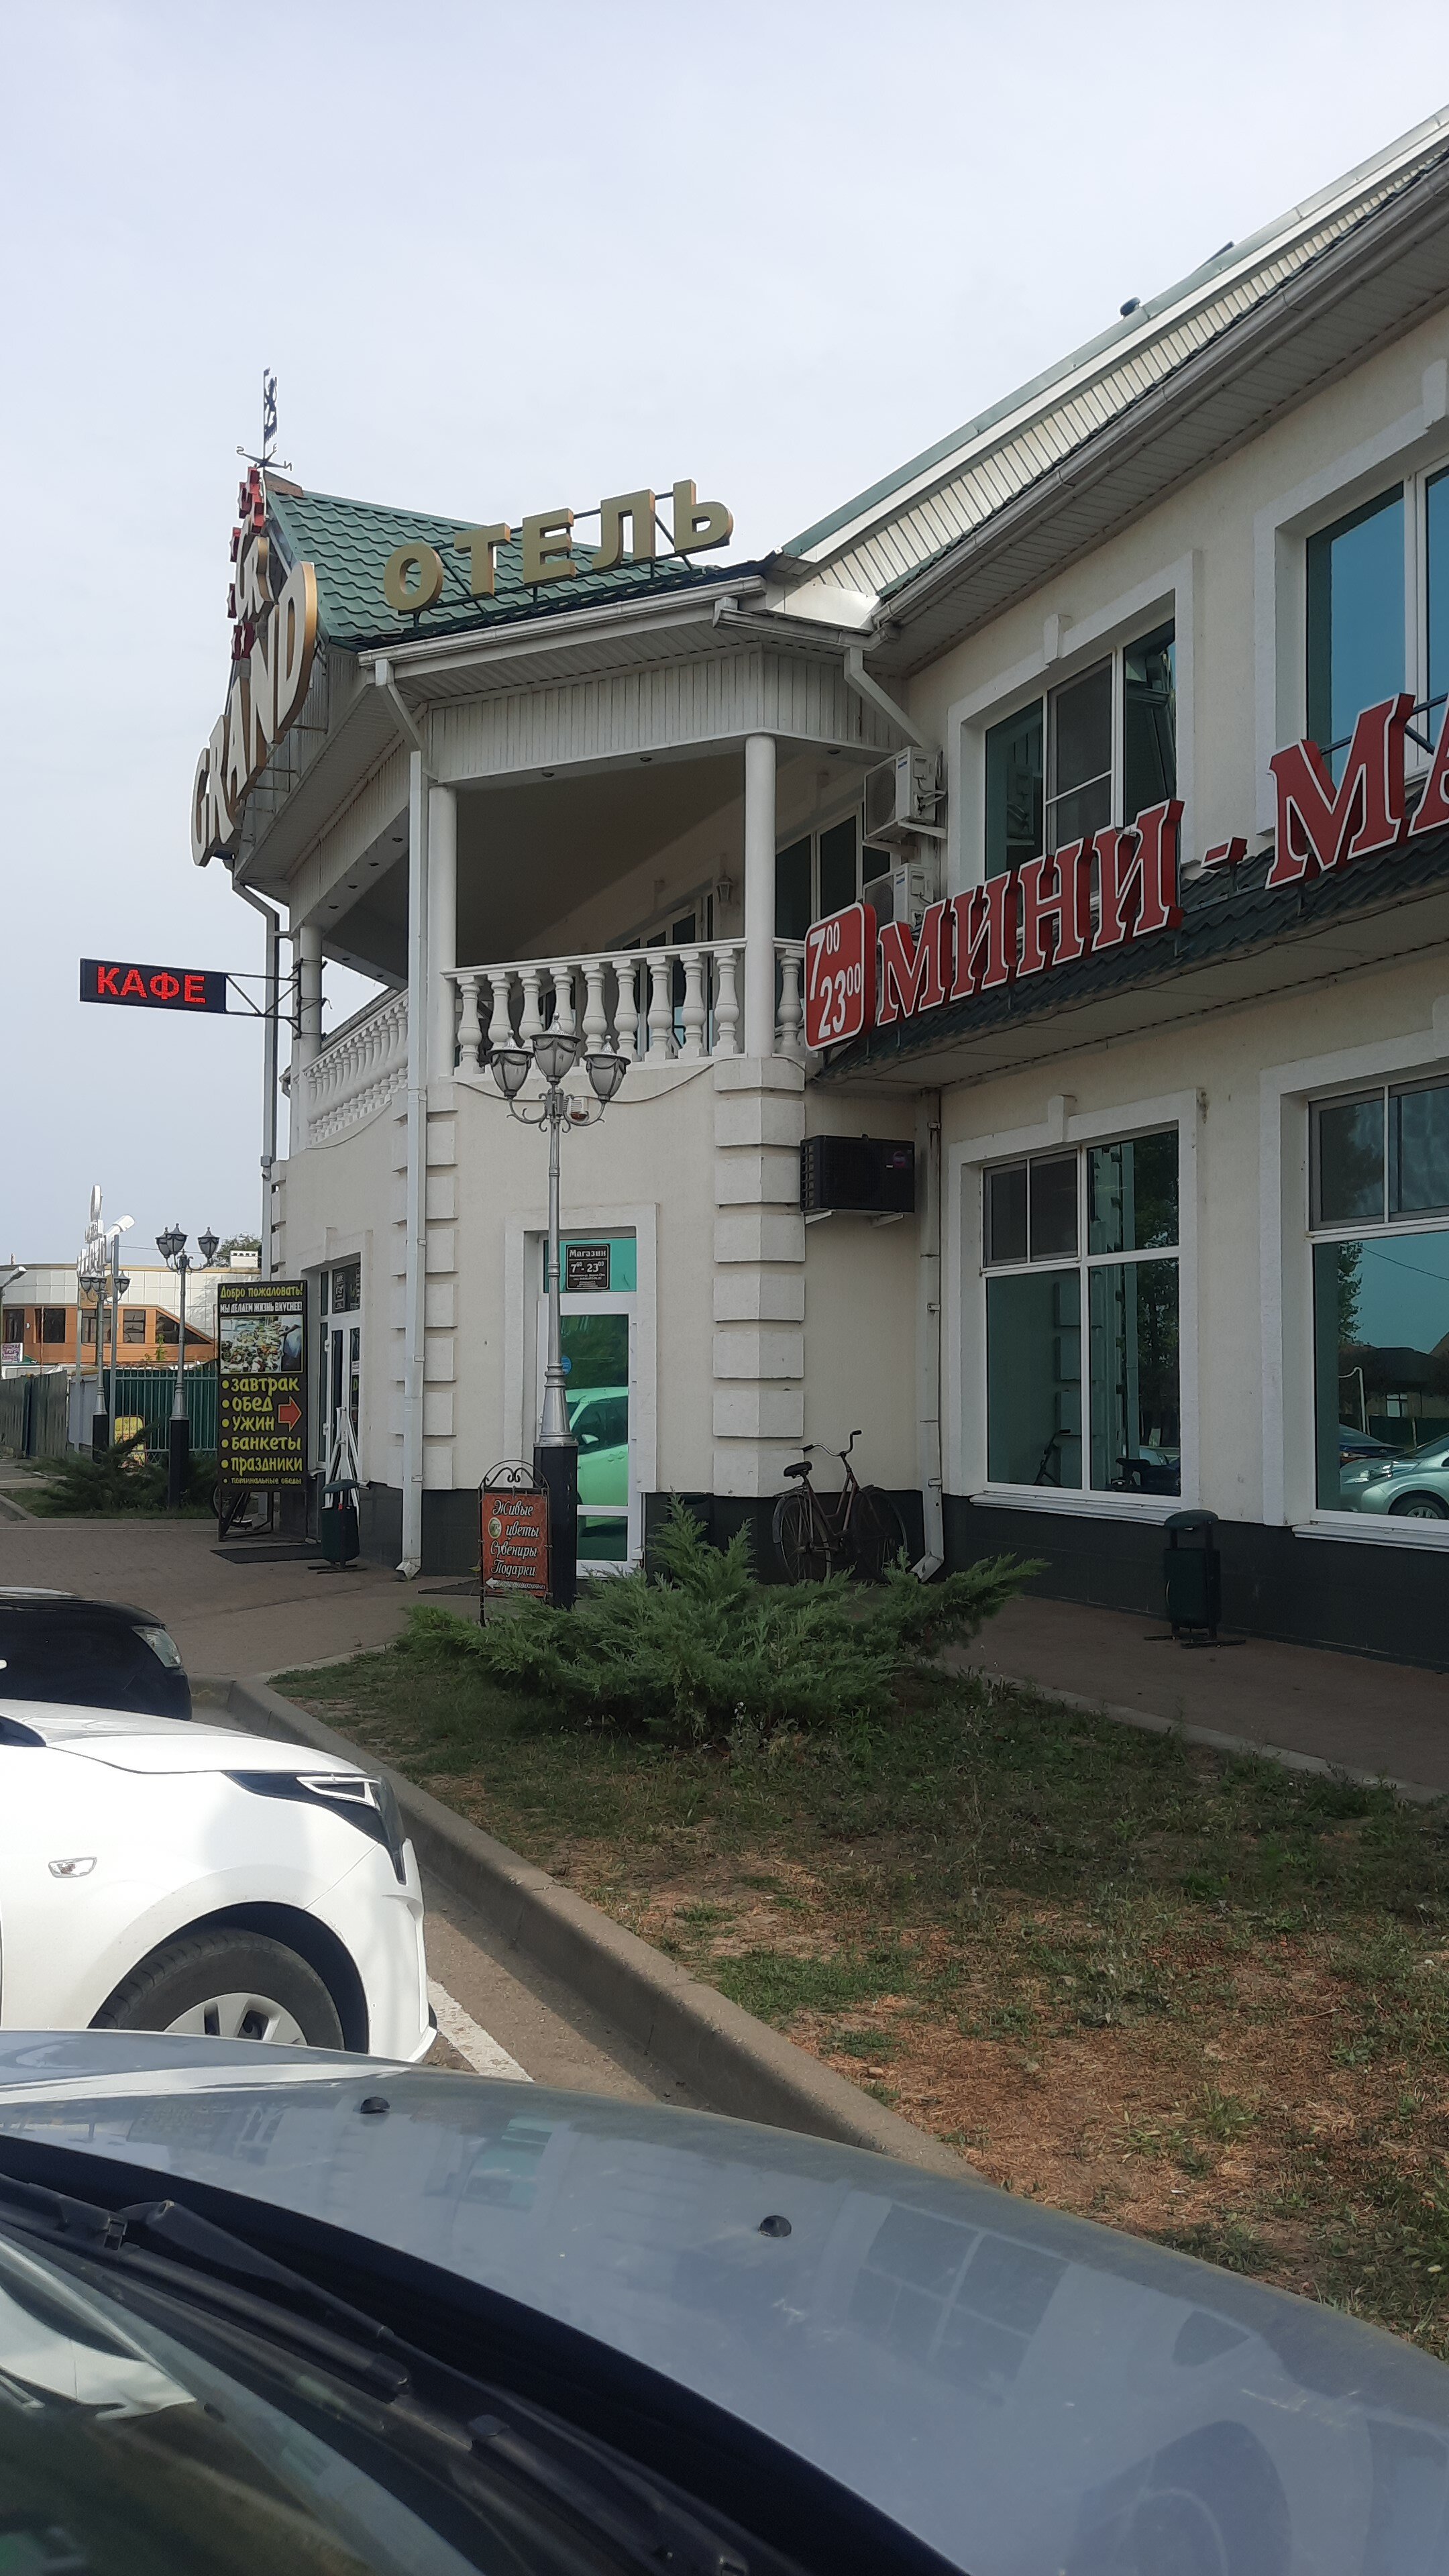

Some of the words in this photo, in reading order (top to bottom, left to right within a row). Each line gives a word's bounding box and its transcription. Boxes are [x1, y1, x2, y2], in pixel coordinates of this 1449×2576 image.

[384, 479, 734, 611] ОТЕЛЬ
[191, 561, 318, 867] GRAND
[877, 798, 1185, 1026] МИНИ
[97, 965, 205, 1004] КАФЕ
[220, 1285, 246, 1301] Добро
[248, 1282, 303, 1297] пожаловать!
[220, 1303, 230, 1313] МЫ
[231, 1303, 253, 1313] ДЕЛАЕМ
[254, 1302, 274, 1312] ЖИЗНЬ
[231, 1456, 302, 1477] праздники
[492, 1499, 533, 1516] Живые
[506, 1520, 539, 1540] цветы
[490, 1540, 537, 1559] Сувениры
[491, 1559, 536, 1578] Подарки
